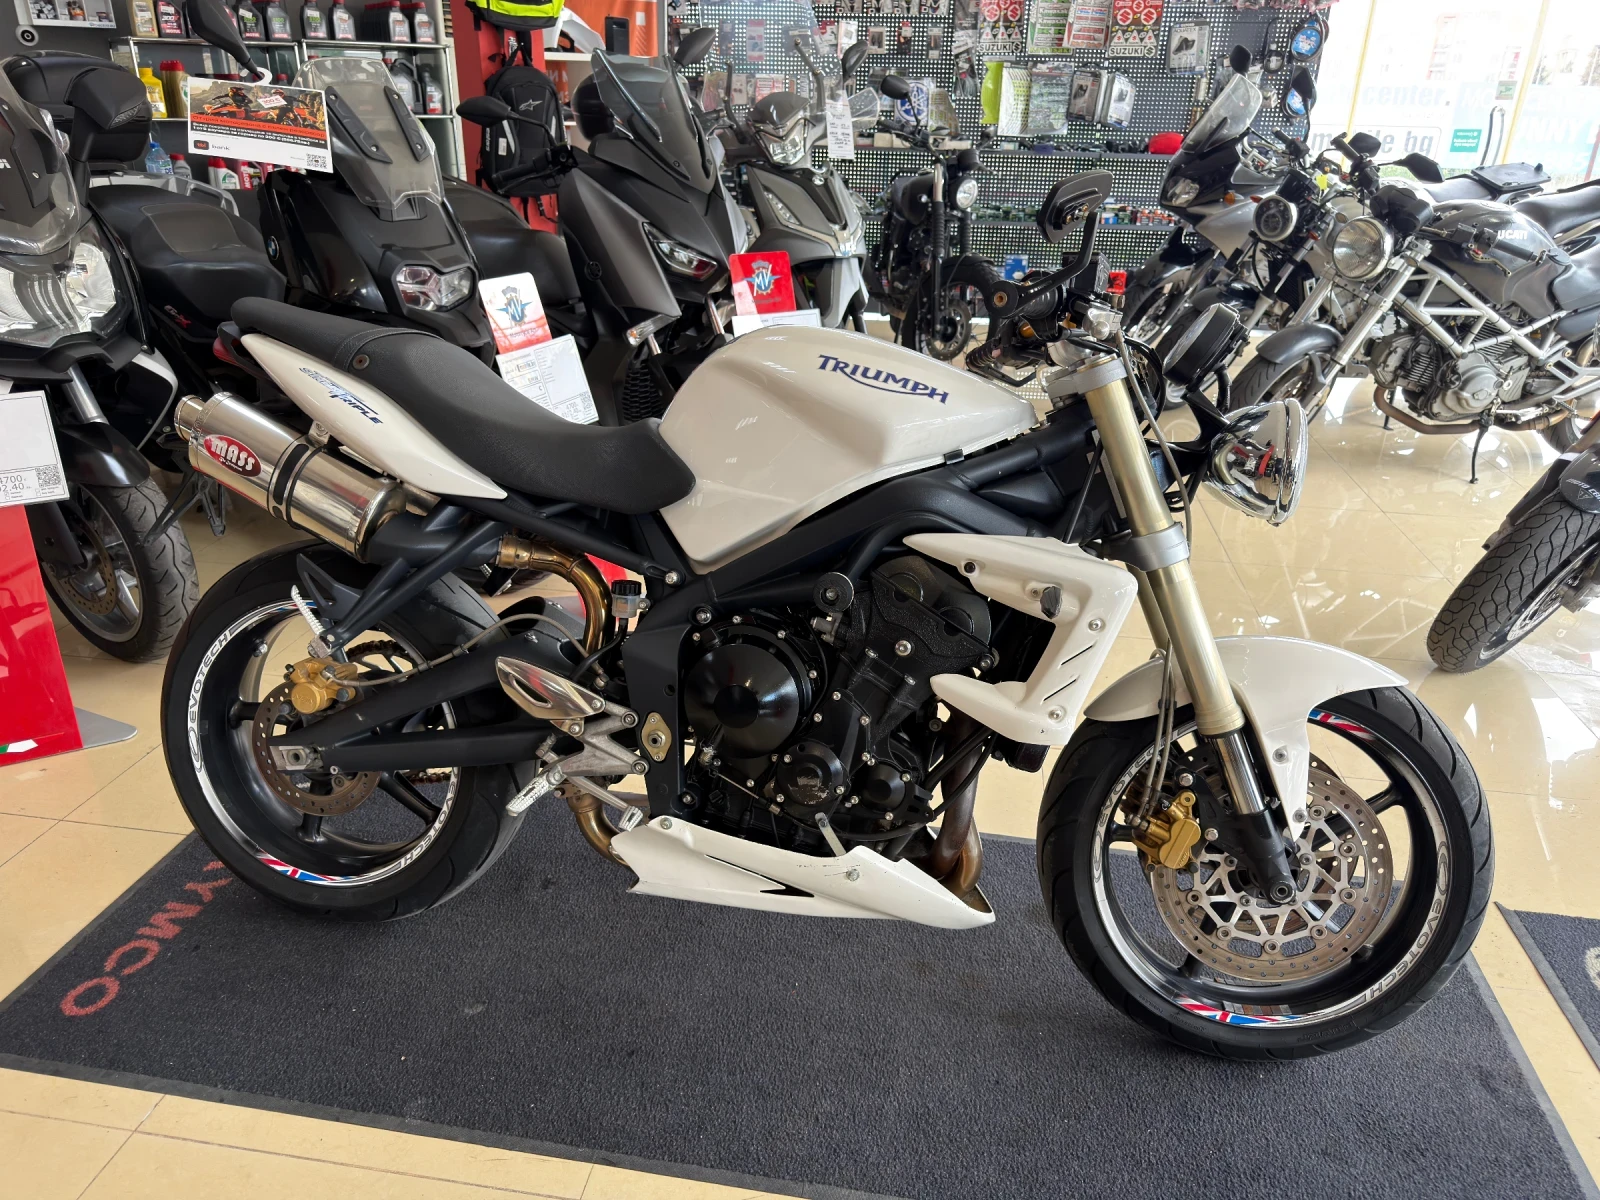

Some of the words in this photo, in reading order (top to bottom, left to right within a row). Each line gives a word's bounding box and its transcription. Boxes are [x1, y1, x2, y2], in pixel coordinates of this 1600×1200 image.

[979, 43, 1011, 52] SUZUKI
[1110, 47, 1143, 55] SUZUKI
[1497, 229, 1528, 240] UCATI
[818, 354, 949, 405] TRIUMPH
[211, 438, 255, 471] MASS
[188, 631, 230, 724] EVOTECH
[402, 780, 458, 866] EVOTECH
[60, 861, 233, 1016] YMCO
[1371, 900, 1444, 1005] EVOTECH
